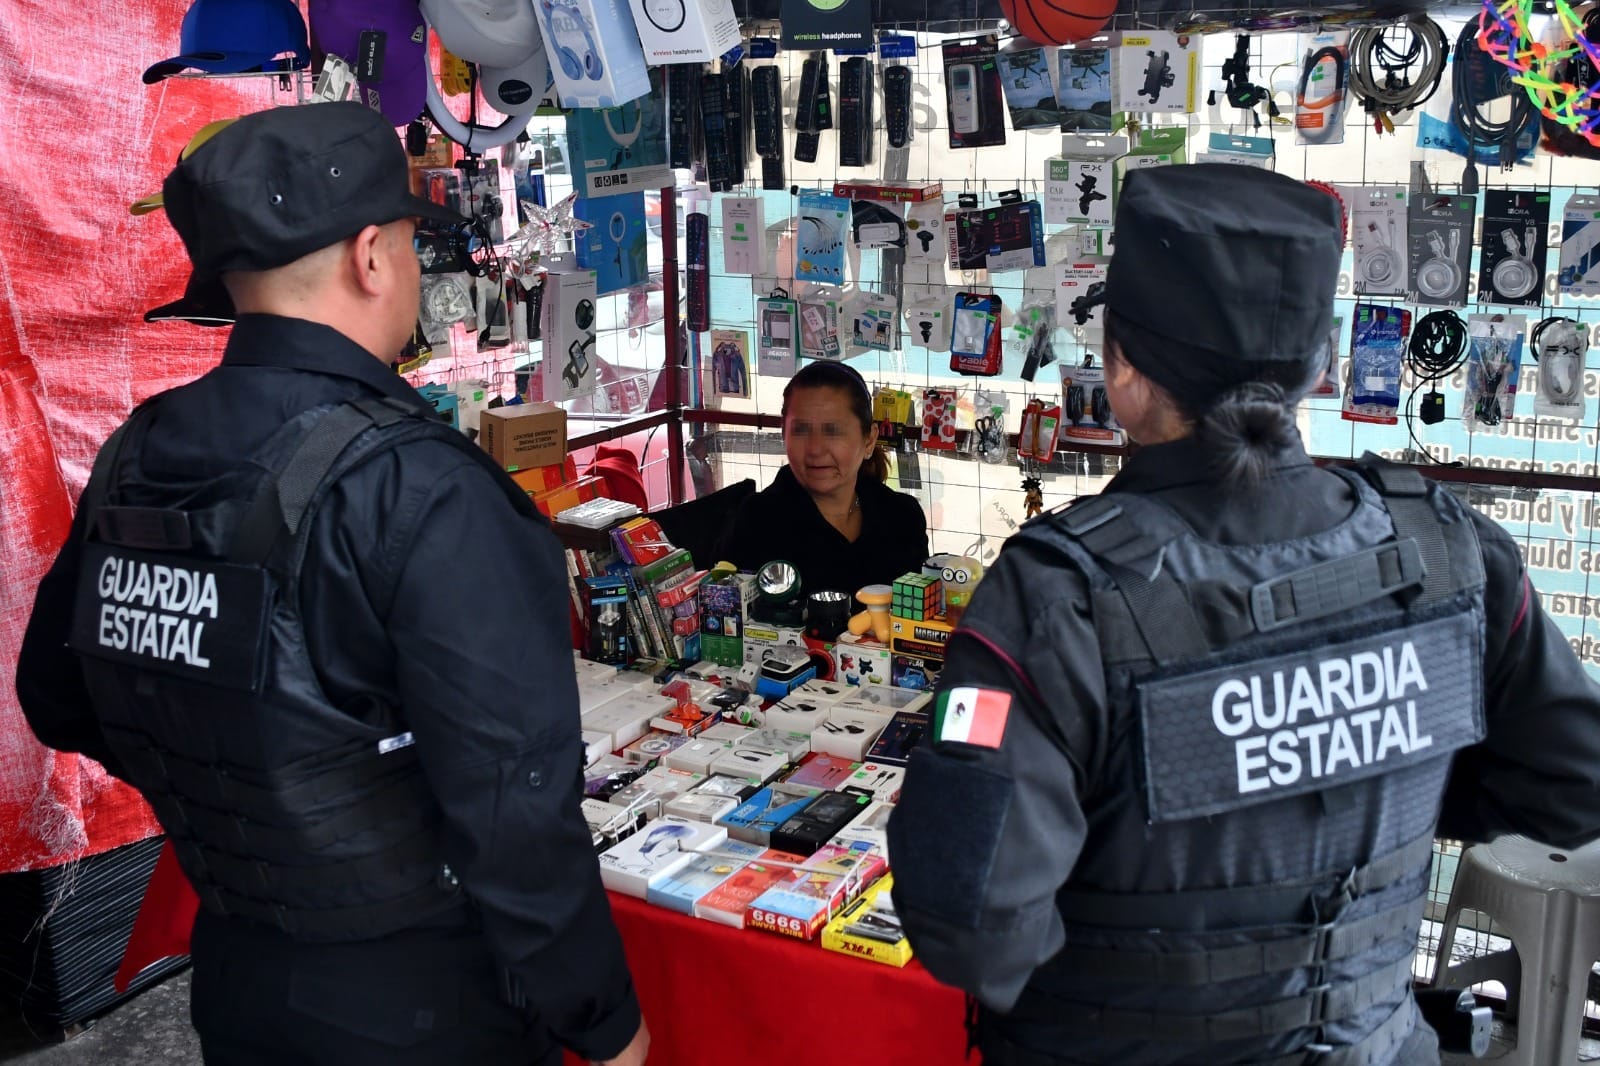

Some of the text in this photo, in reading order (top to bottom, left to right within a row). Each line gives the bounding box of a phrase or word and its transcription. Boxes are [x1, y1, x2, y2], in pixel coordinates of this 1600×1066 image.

[821, 31, 862, 40] headphones
[672, 48, 703, 56] headphones
[1354, 281, 1367, 293] 2M
[1405, 290, 1419, 302] 2M
[1478, 290, 1493, 303] 2M
[98, 556, 219, 618] GUARDIA
[98, 603, 211, 669] ESTATAL
[1212, 641, 1428, 736] GUARDIA
[1235, 699, 1433, 794] ESTATAL
